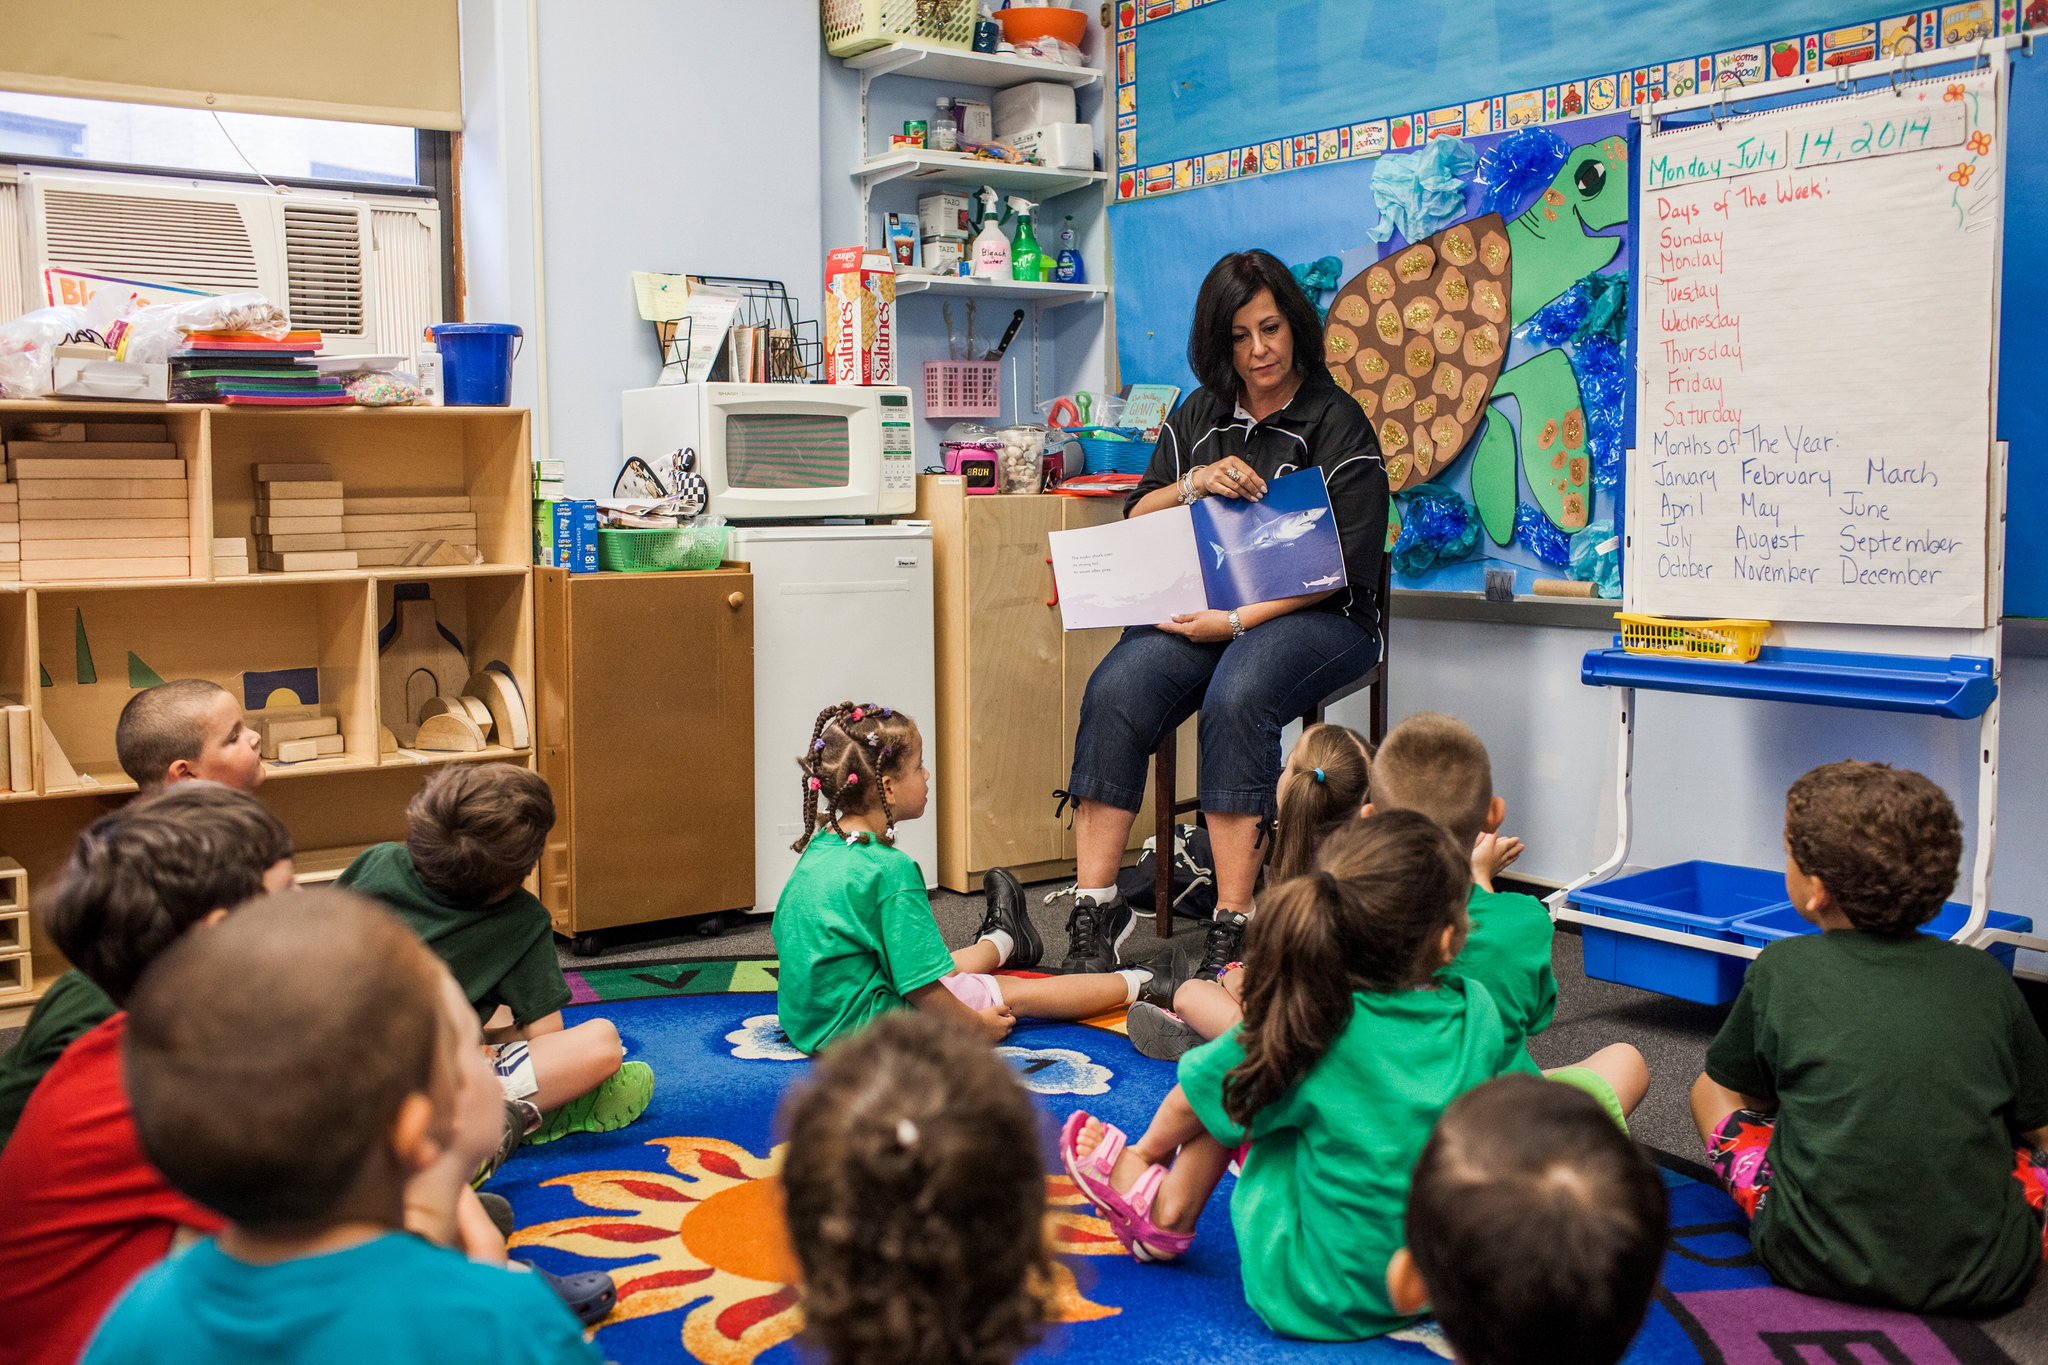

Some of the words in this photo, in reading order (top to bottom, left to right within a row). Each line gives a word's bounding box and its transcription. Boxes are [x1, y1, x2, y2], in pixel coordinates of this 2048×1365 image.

[1721, 52, 1758, 67] Welcome
[1736, 61, 1745, 69] to
[1355, 126, 1383, 137] Welcome
[1649, 155, 1722, 187] Monday
[1728, 137, 1777, 169] July
[1800, 128, 1841, 163] 14,
[1850, 117, 1932, 153] 2014
[1657, 197, 1701, 225] Days
[1713, 190, 1732, 221] of
[1736, 185, 1768, 208] The
[1777, 176, 1832, 204] Week:
[1660, 227, 1724, 250] Sunday
[1661, 250, 1724, 275] Monday
[1660, 277, 1720, 309] Tuesday
[837, 301, 854, 381] Saltines
[874, 301, 890, 381] Saltines
[1661, 309, 1740, 343] Wednesday
[1660, 339, 1744, 372] Thursday
[1668, 367, 1724, 406] Friday
[1663, 400, 1742, 444] Saturday
[1653, 431, 1712, 456] Months
[1717, 428, 1741, 454] of
[1743, 424, 1779, 454] The
[1784, 425, 1840, 463] Year:
[1652, 460, 1717, 492] January
[1742, 458, 1832, 497] February
[1867, 458, 1939, 488] March
[1661, 492, 1704, 523] April
[1741, 492, 1779, 528] May
[1839, 491, 1891, 520] June
[1839, 524, 1963, 555] September
[1658, 553, 1714, 580] October
[1734, 555, 1821, 585] November
[1841, 555, 1943, 586] December
